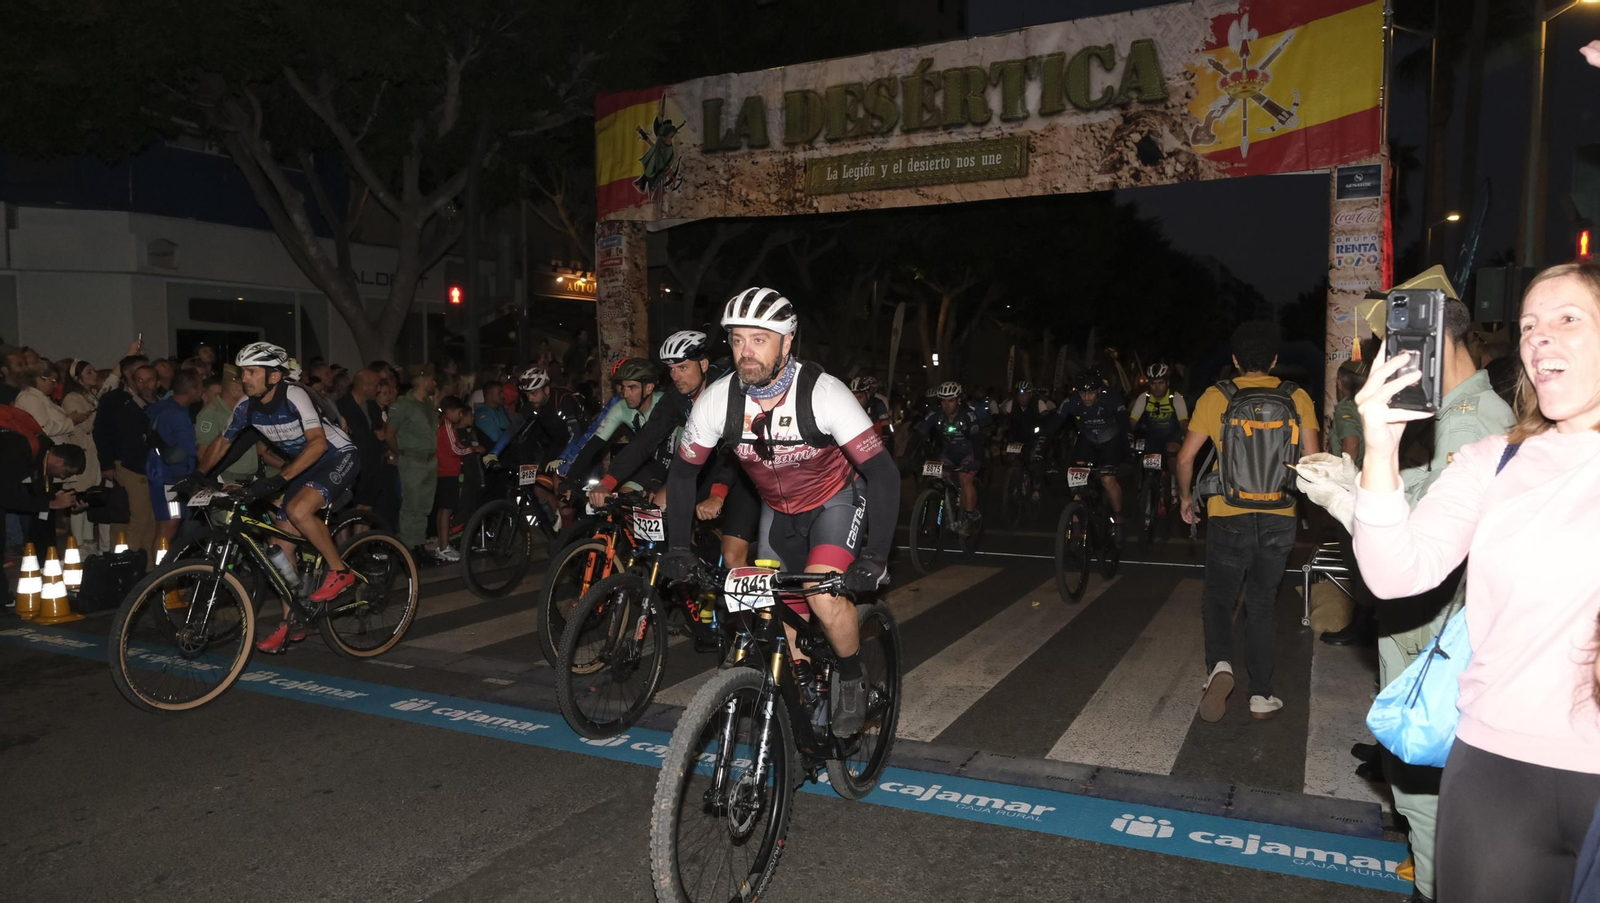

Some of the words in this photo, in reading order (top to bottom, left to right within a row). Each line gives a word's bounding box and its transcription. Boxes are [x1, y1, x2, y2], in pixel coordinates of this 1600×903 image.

[702, 96, 769, 153] LA
[783, 38, 1170, 146] DESÉRTICA
[826, 167, 838, 181] La
[842, 162, 876, 181] Legión
[880, 164, 888, 178] y
[893, 159, 903, 174] el
[907, 157, 951, 173] desierto
[956, 155, 976, 168] nos
[981, 153, 1002, 166] une
[1336, 235, 1377, 243] GRUPO
[1336, 243, 1378, 254] RENTA
[1336, 254, 1378, 267] TODO
[926, 463, 941, 473] 8875
[1070, 472, 1087, 481] 7436
[637, 518, 661, 532] 7322
[733, 574, 769, 597] 7845
[269, 678, 369, 698] cajamar
[432, 707, 550, 732] cajamar
[879, 781, 1056, 816] cajamar
[956, 803, 992, 814] CAJA
[995, 808, 1043, 822] RURAL
[1188, 830, 1402, 874] cajamar
[757, 846, 780, 897] HUTCHINSON
[1292, 858, 1339, 871] CAJA
